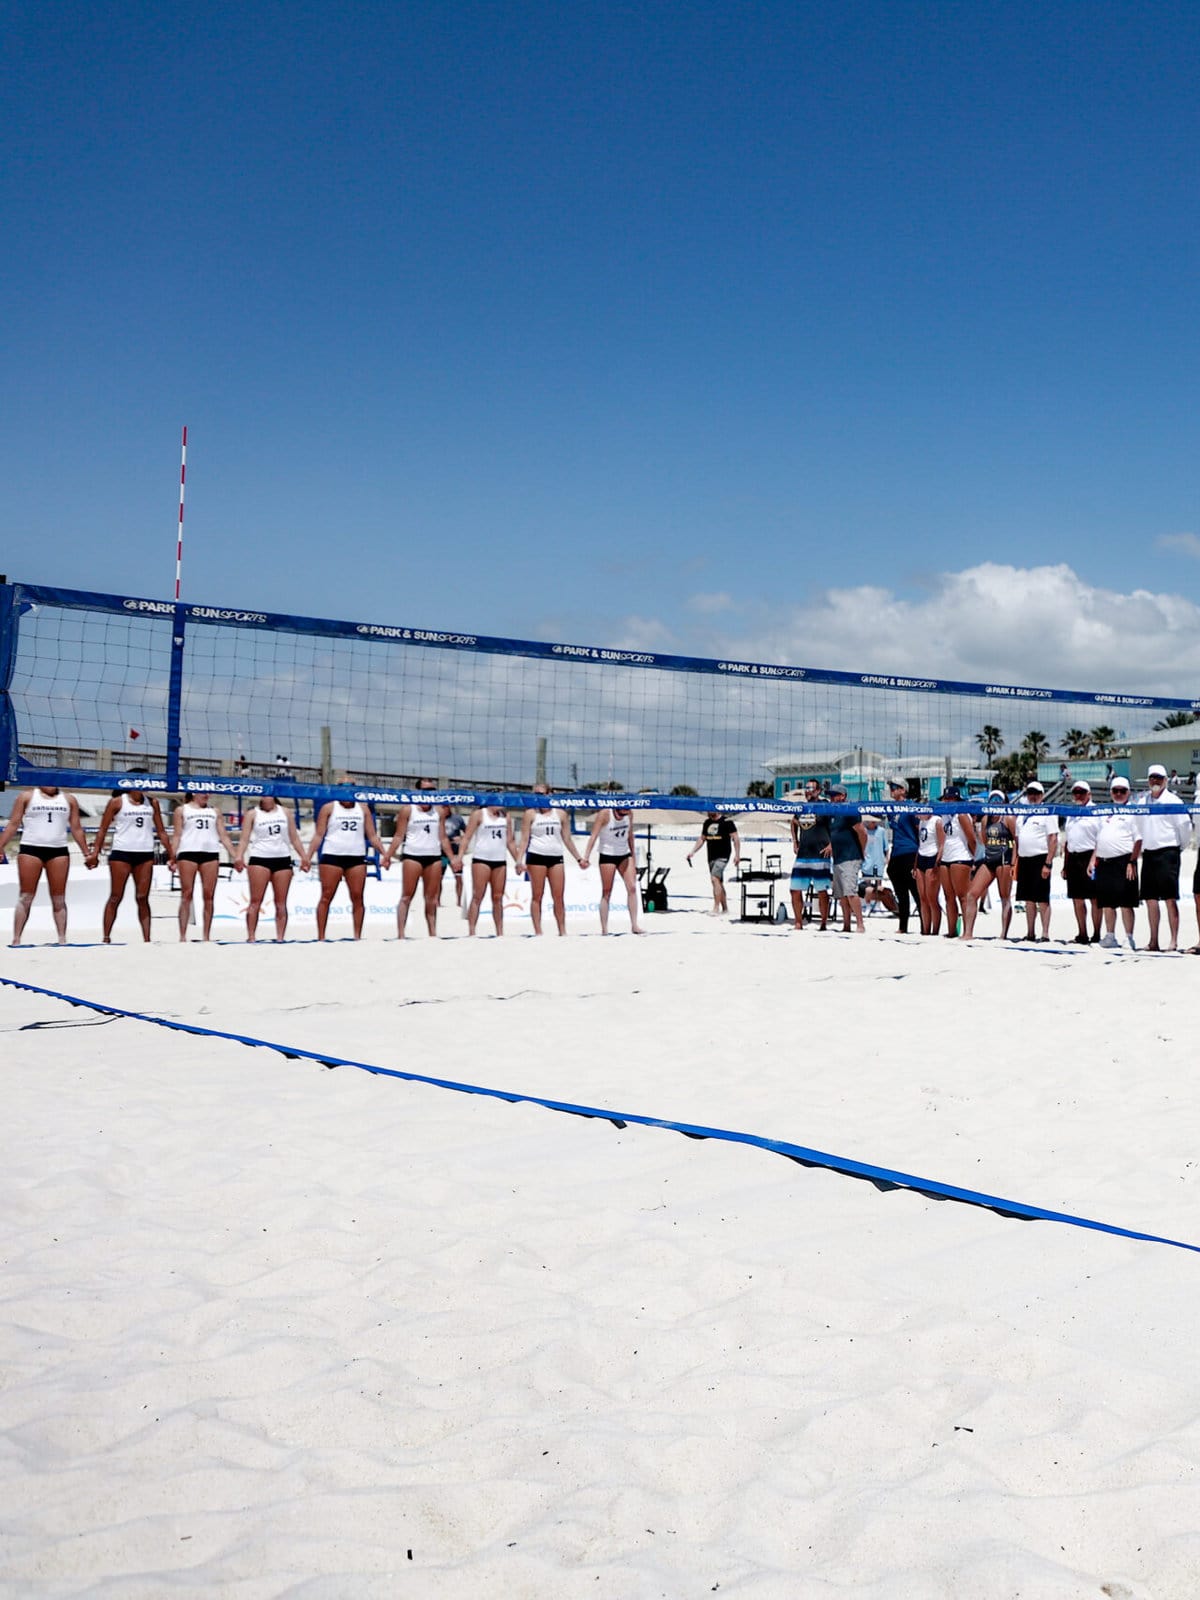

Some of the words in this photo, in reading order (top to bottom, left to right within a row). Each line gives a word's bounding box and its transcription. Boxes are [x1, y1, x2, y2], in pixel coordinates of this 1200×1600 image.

[139, 601, 176, 614] PARK
[369, 626, 401, 638] PARK
[402, 629, 411, 639] &
[563, 646, 590, 657] PARK
[591, 650, 599, 658] &
[727, 663, 750, 673] PARK
[367, 792, 400, 802] PARK
[401, 793, 411, 803] &
[560, 799, 587, 807] PARK
[47, 812, 53, 823] 1
[136, 817, 144, 828] 9
[196, 820, 209, 830] 31
[268, 825, 281, 836] 13
[341, 821, 357, 832] 32
[423, 824, 430, 834] 4
